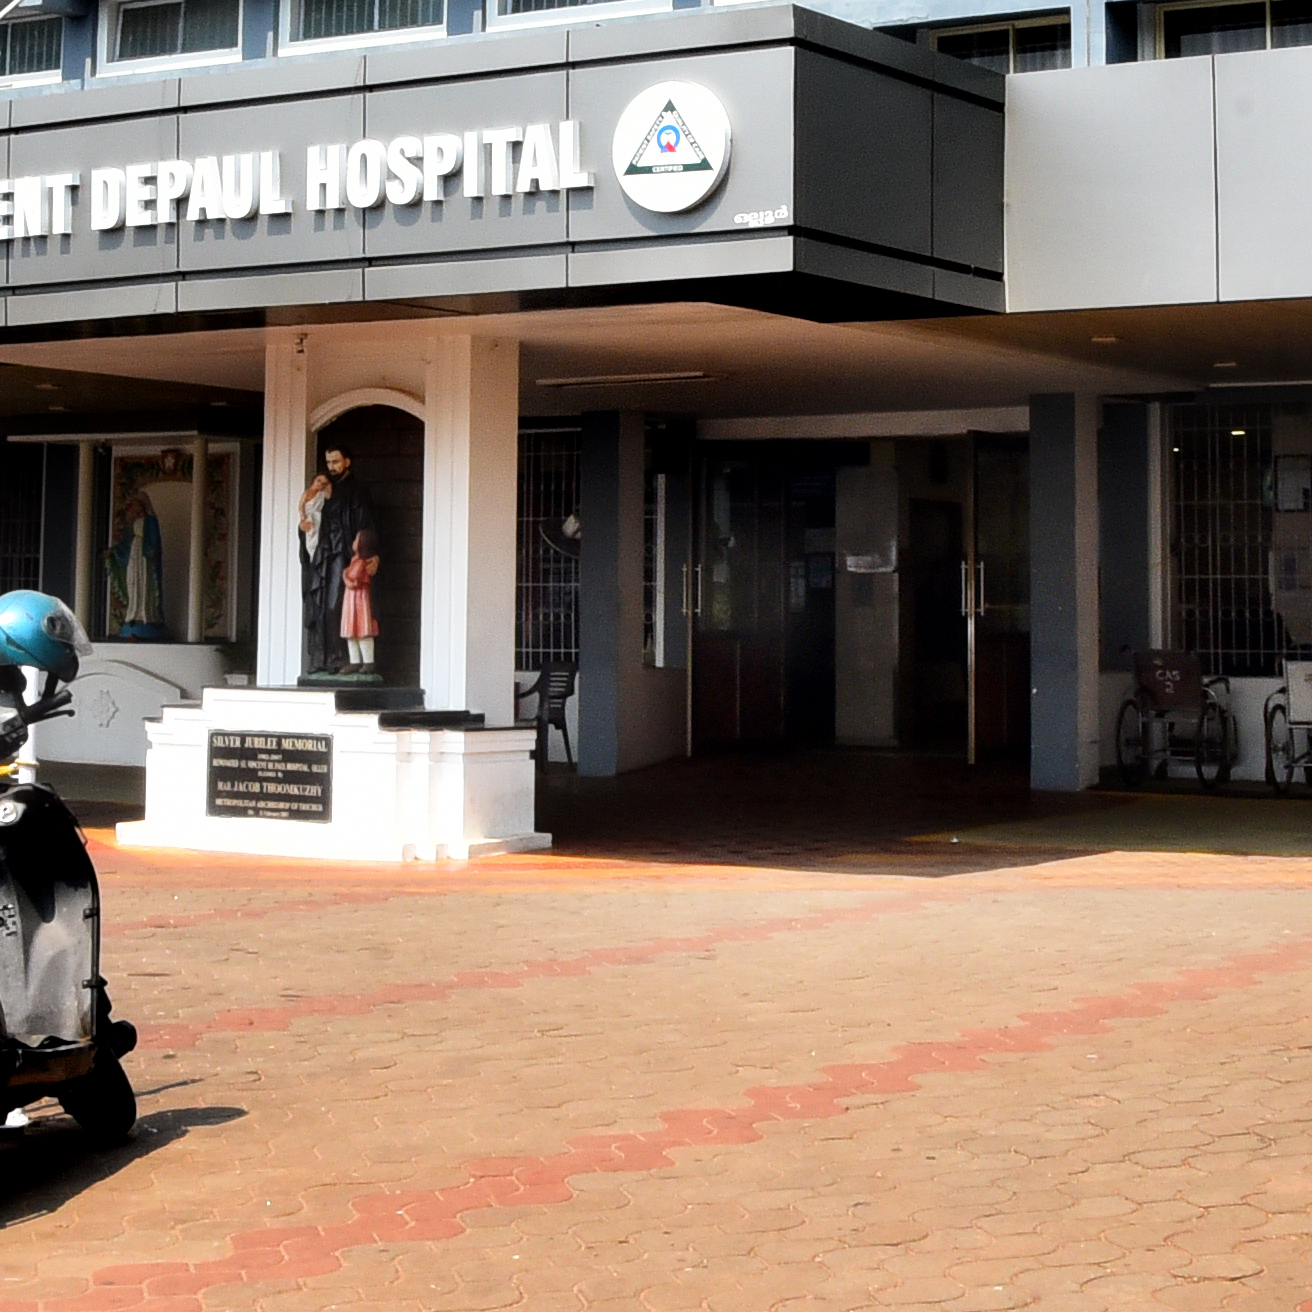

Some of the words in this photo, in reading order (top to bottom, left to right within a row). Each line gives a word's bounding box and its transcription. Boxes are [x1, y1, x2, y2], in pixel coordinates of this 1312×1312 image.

[89, 151, 292, 231] DEPAUL
[306, 120, 595, 210] HOSPITAL
[212, 735, 241, 748] SILVER
[244, 736, 279, 750] JUBILEE
[281, 737, 328, 752] MEMORIAL
[233, 781, 261, 793] JACOB
